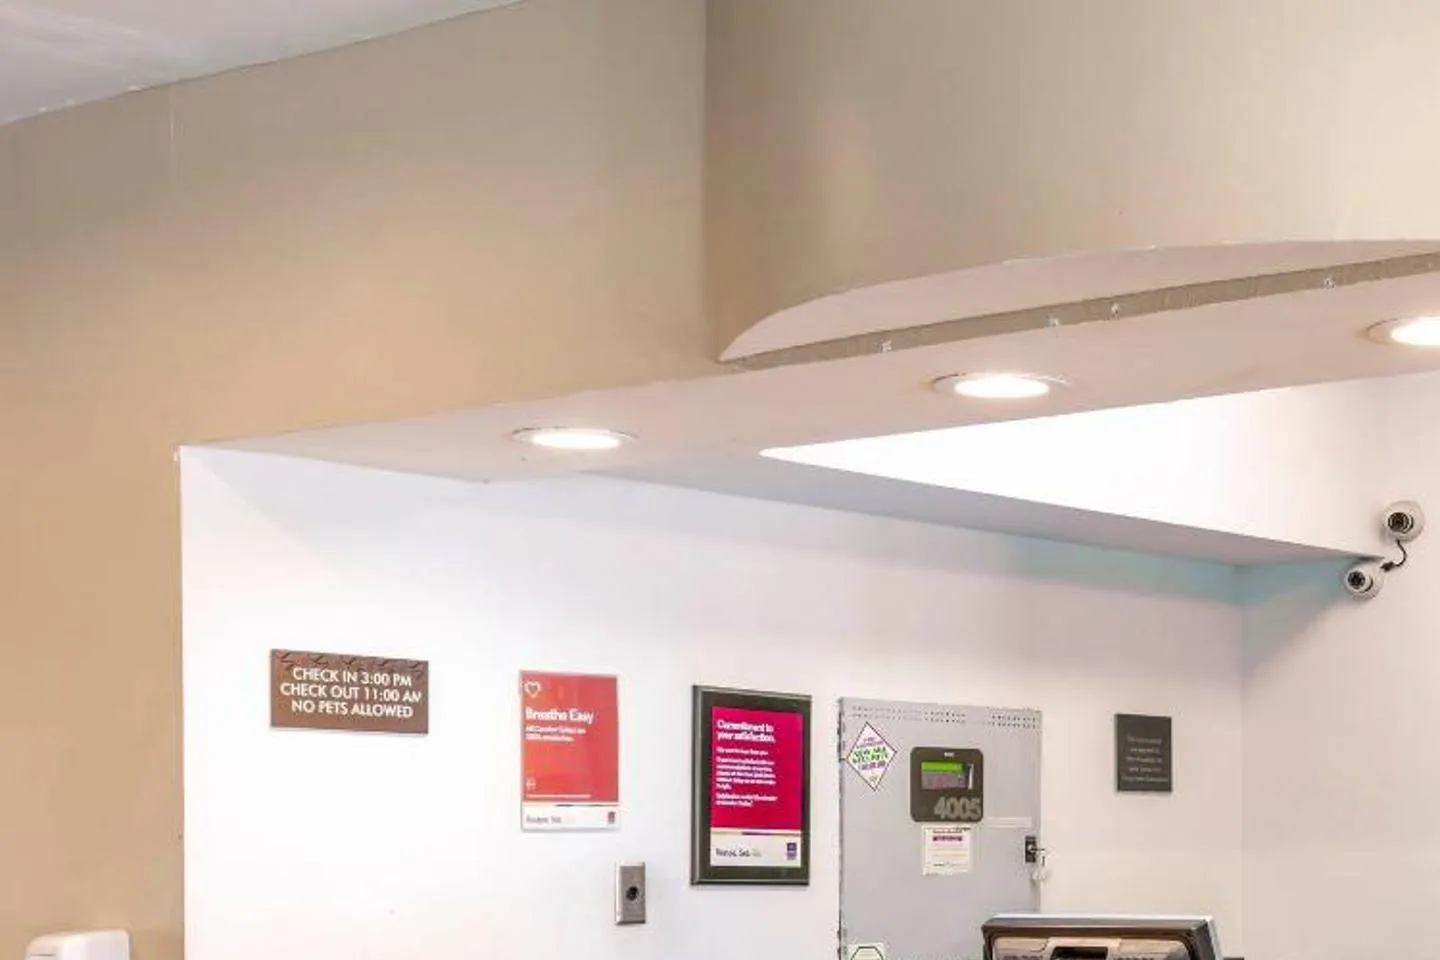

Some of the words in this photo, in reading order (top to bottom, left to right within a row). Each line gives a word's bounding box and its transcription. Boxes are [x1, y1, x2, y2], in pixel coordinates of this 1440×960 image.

[293, 666, 340, 682] CHECK
[343, 670, 358, 683] IN
[361, 671, 390, 686] 3:00
[393, 673, 412, 687] PM
[280, 682, 328, 698] CHECK
[331, 685, 360, 700] OUT
[364, 686, 400, 702] 11:00
[291, 699, 316, 713] NO
[318, 700, 348, 715] PETS
[351, 702, 414, 718] ALLOWED
[933, 795, 982, 820] 4005
